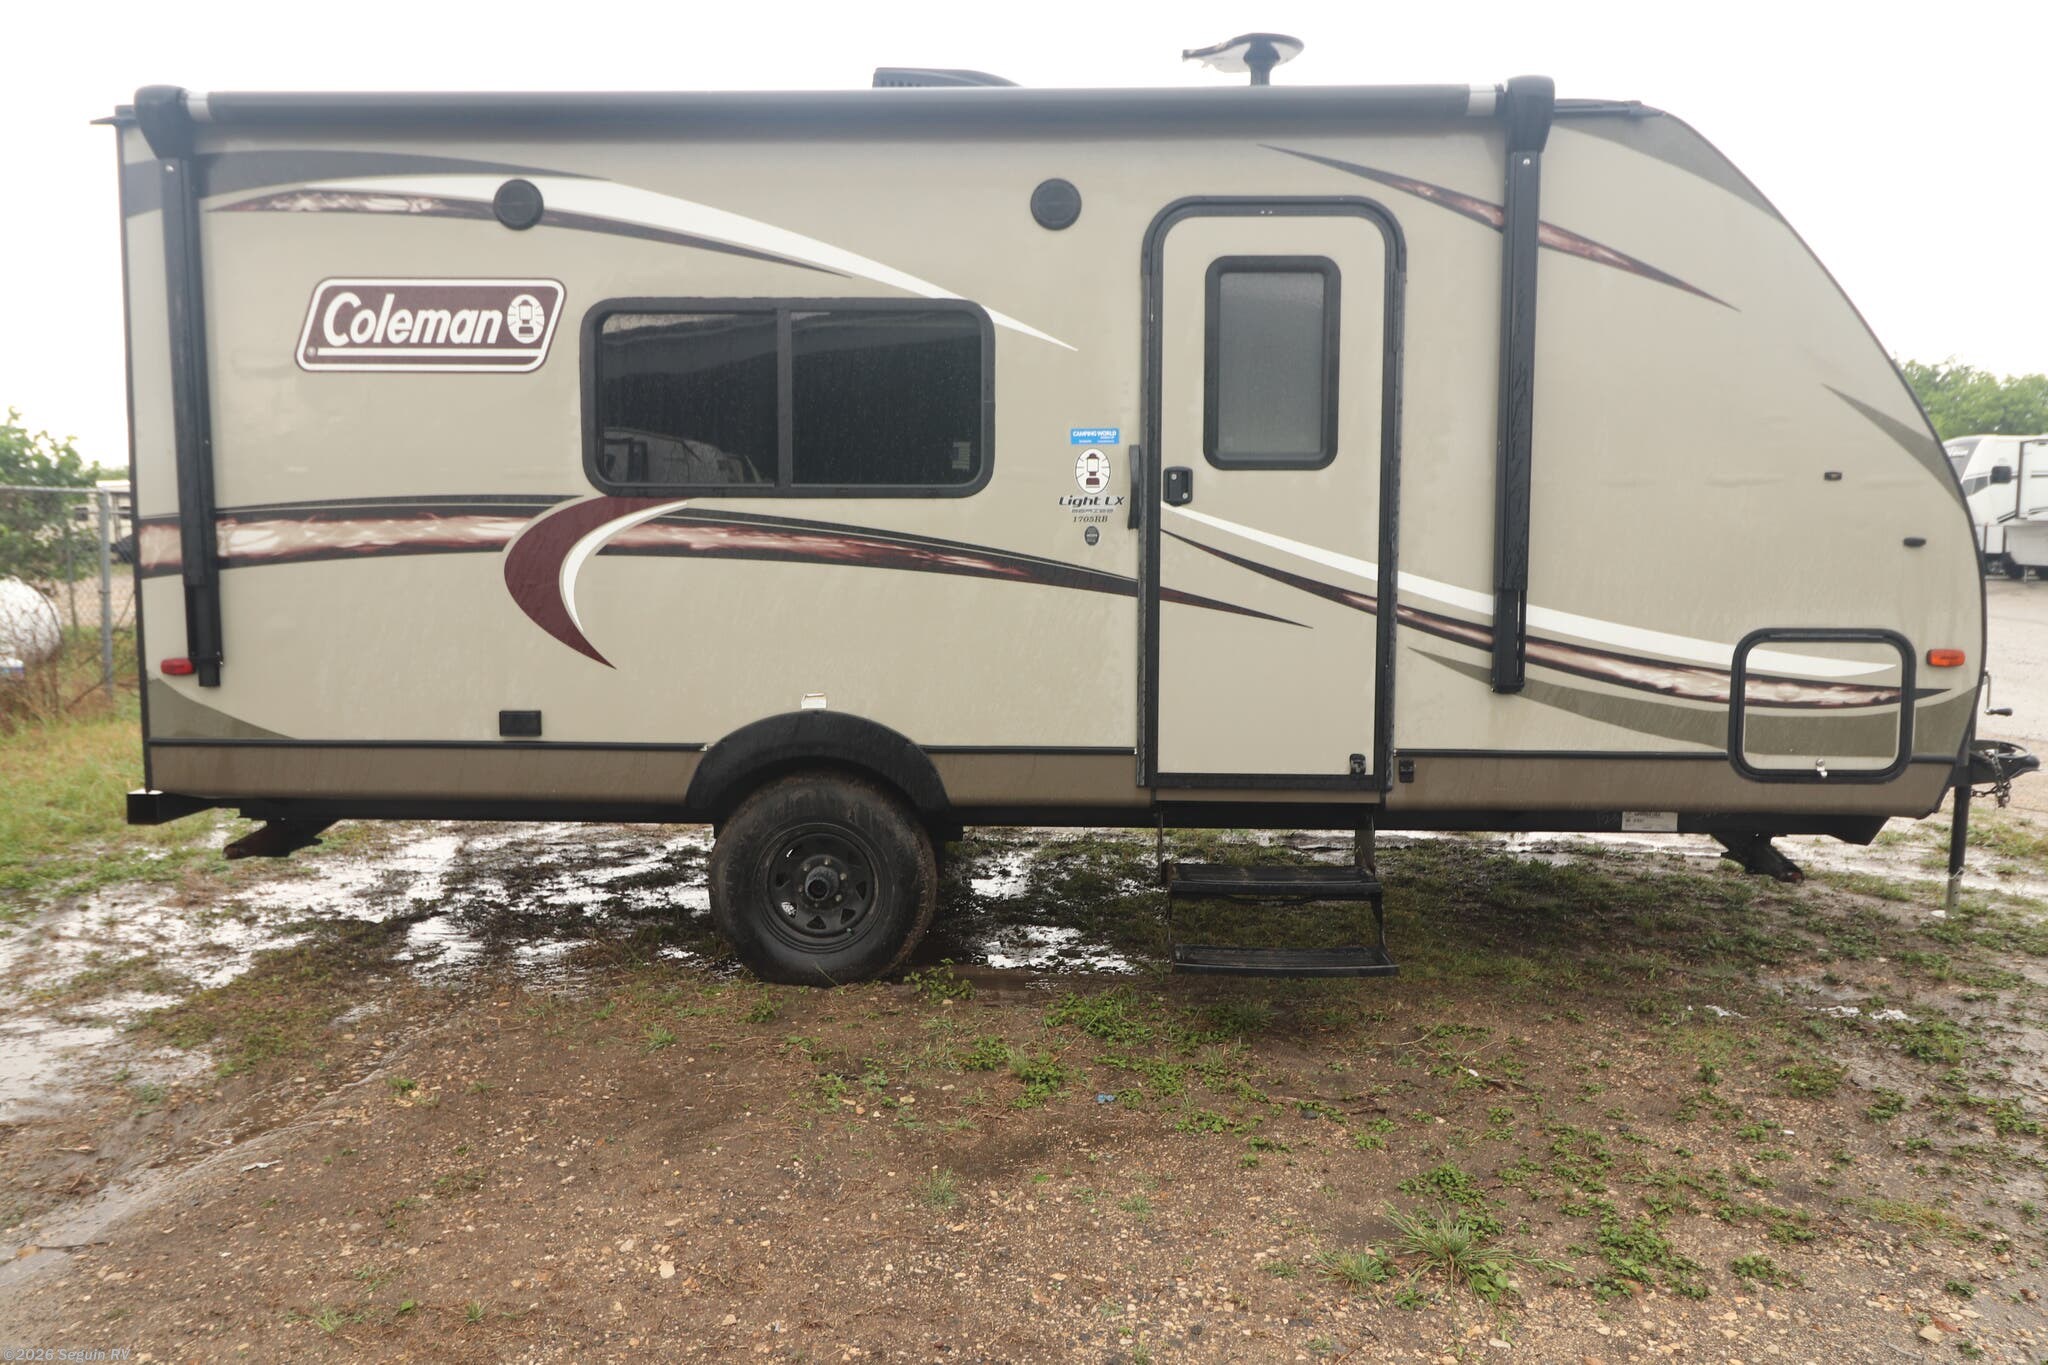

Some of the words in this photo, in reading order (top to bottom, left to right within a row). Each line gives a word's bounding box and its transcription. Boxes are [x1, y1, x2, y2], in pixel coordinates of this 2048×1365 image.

[323, 292, 503, 347] Coleman
[1059, 495, 1101, 507] Light
[1105, 496, 1124, 505] LX
